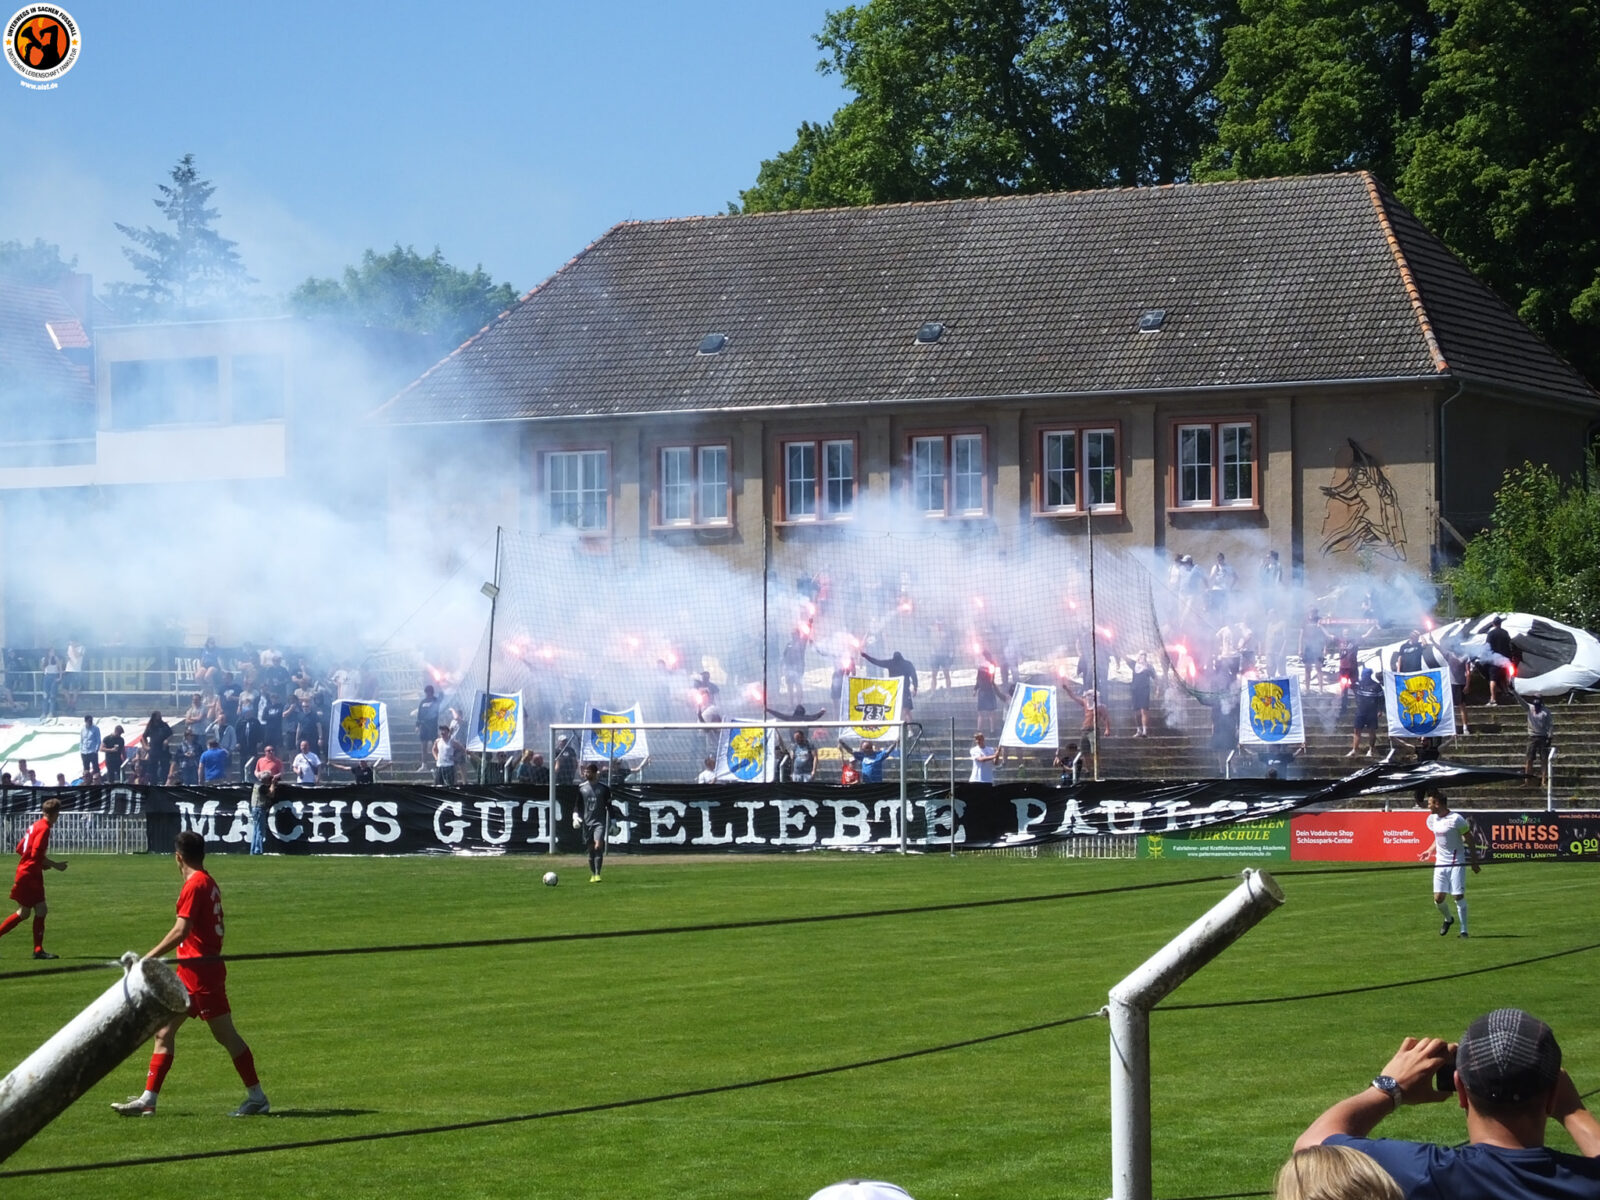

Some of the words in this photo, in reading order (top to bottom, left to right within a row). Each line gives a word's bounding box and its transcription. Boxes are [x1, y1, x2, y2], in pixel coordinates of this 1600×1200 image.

[175, 800, 401, 843] MACH'S
[433, 800, 562, 844] GUT
[1188, 830, 1270, 841] FAHRSCHULE
[1338, 830, 1354, 838] Shop
[1491, 825, 1559, 841] FITNESS
[1297, 837, 1354, 845] Schlosspark-Center
[1491, 842, 1525, 850] CrossFit
[1525, 842, 1532, 850] &
[1533, 842, 1559, 850] Boxen
